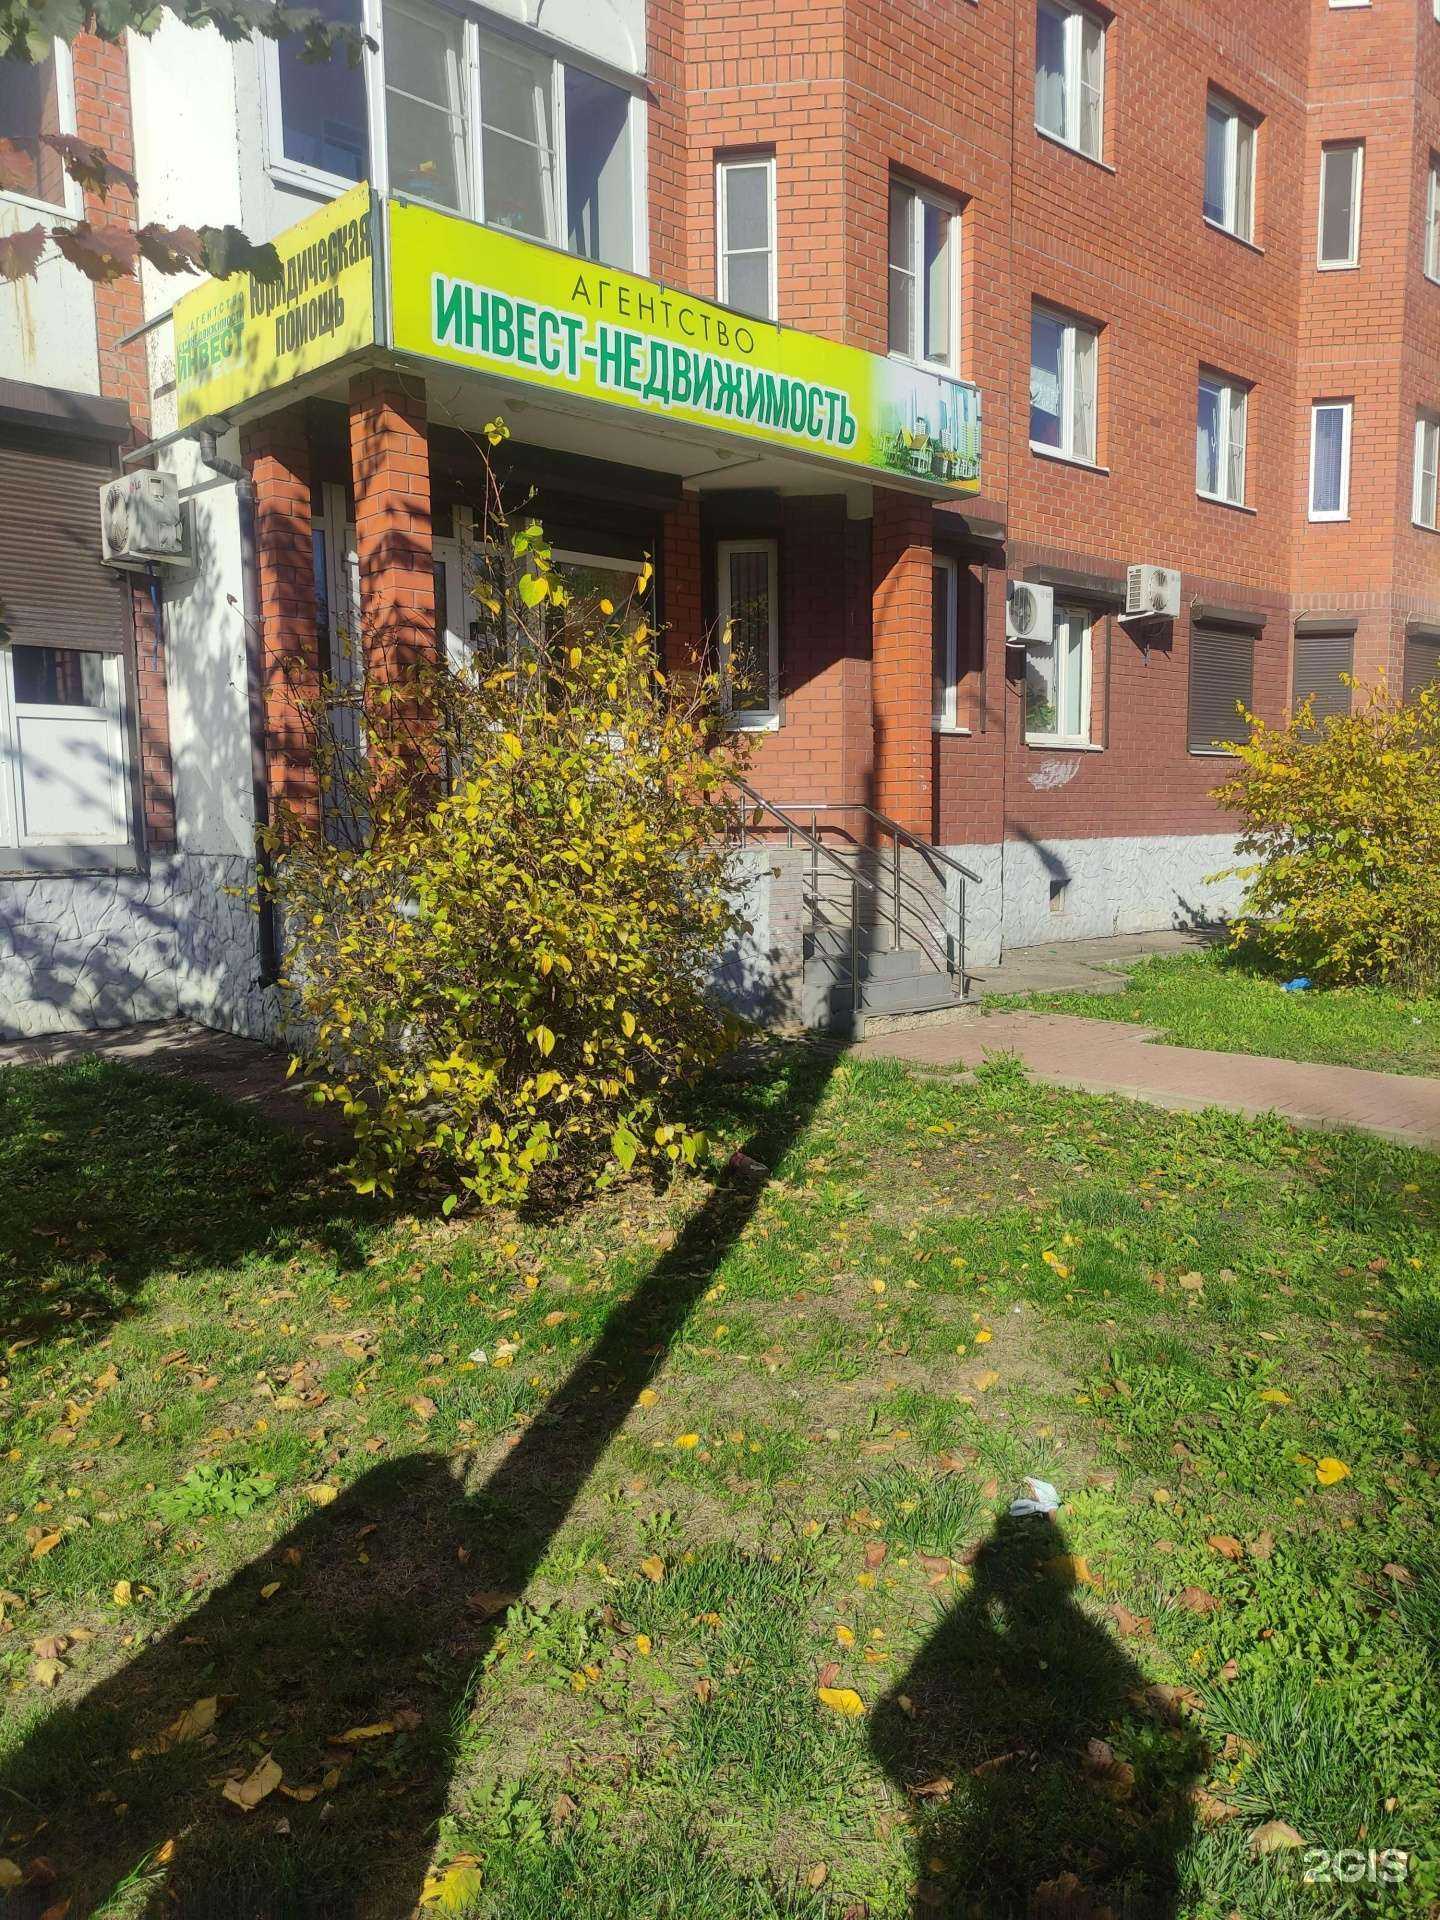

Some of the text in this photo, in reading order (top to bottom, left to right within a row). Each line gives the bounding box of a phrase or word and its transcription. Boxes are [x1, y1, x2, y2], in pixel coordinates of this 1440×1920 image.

[190, 291, 244, 331] АГЕНТСТВО
[571, 274, 754, 354] АГЕНТСТВО
[177, 321, 244, 384] ИНВЕСТ
[436, 278, 855, 445] ИНВЕСТ-НЕДВИЖИМОСТЬ
